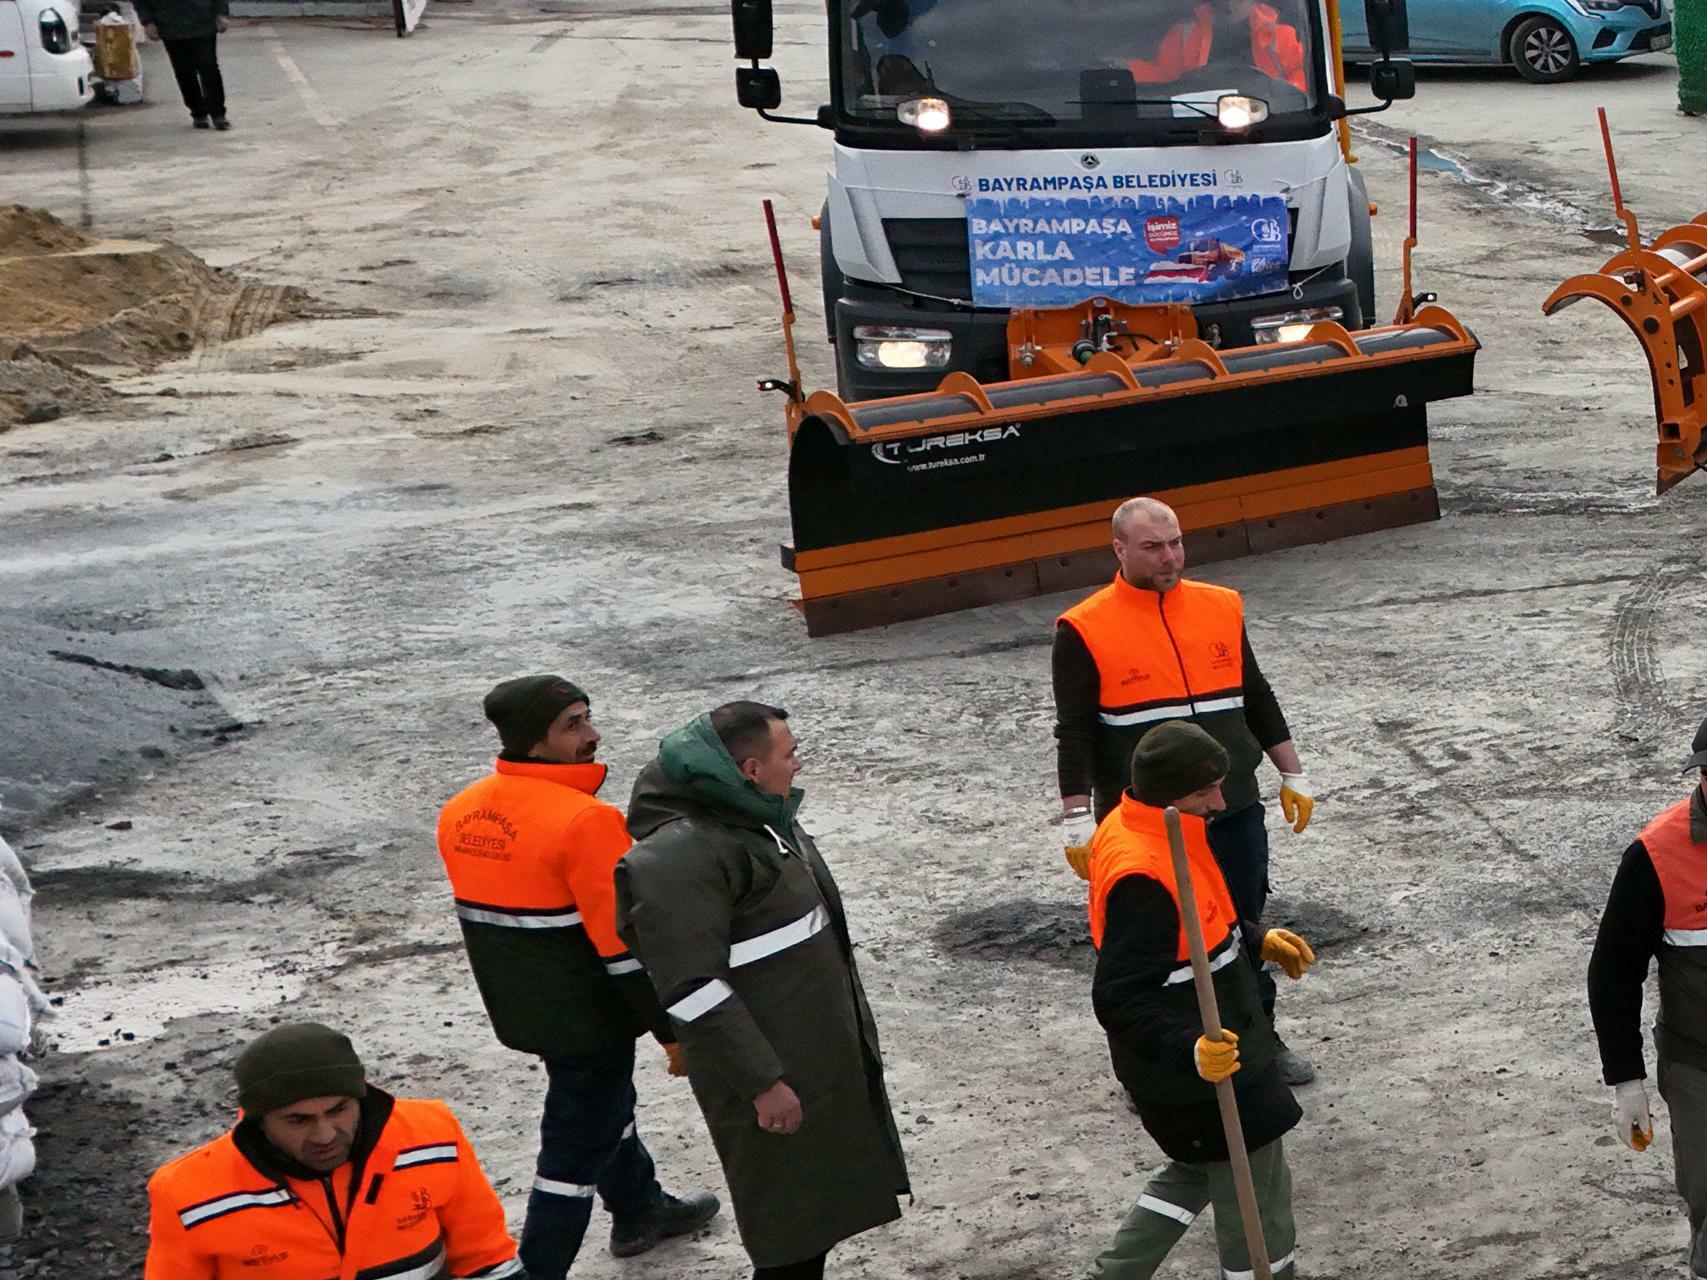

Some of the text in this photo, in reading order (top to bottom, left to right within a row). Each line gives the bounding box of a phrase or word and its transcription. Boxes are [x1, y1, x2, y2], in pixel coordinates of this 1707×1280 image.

[978, 169, 1217, 193] BAYRAMPAŞA BELEDİYESİ
[972, 218, 1132, 238] BAYRAMPAŞA
[975, 240, 1074, 262] KARLA
[976, 263, 1135, 287] MÜCADELE
[886, 425, 1021, 455] TUREKSA
